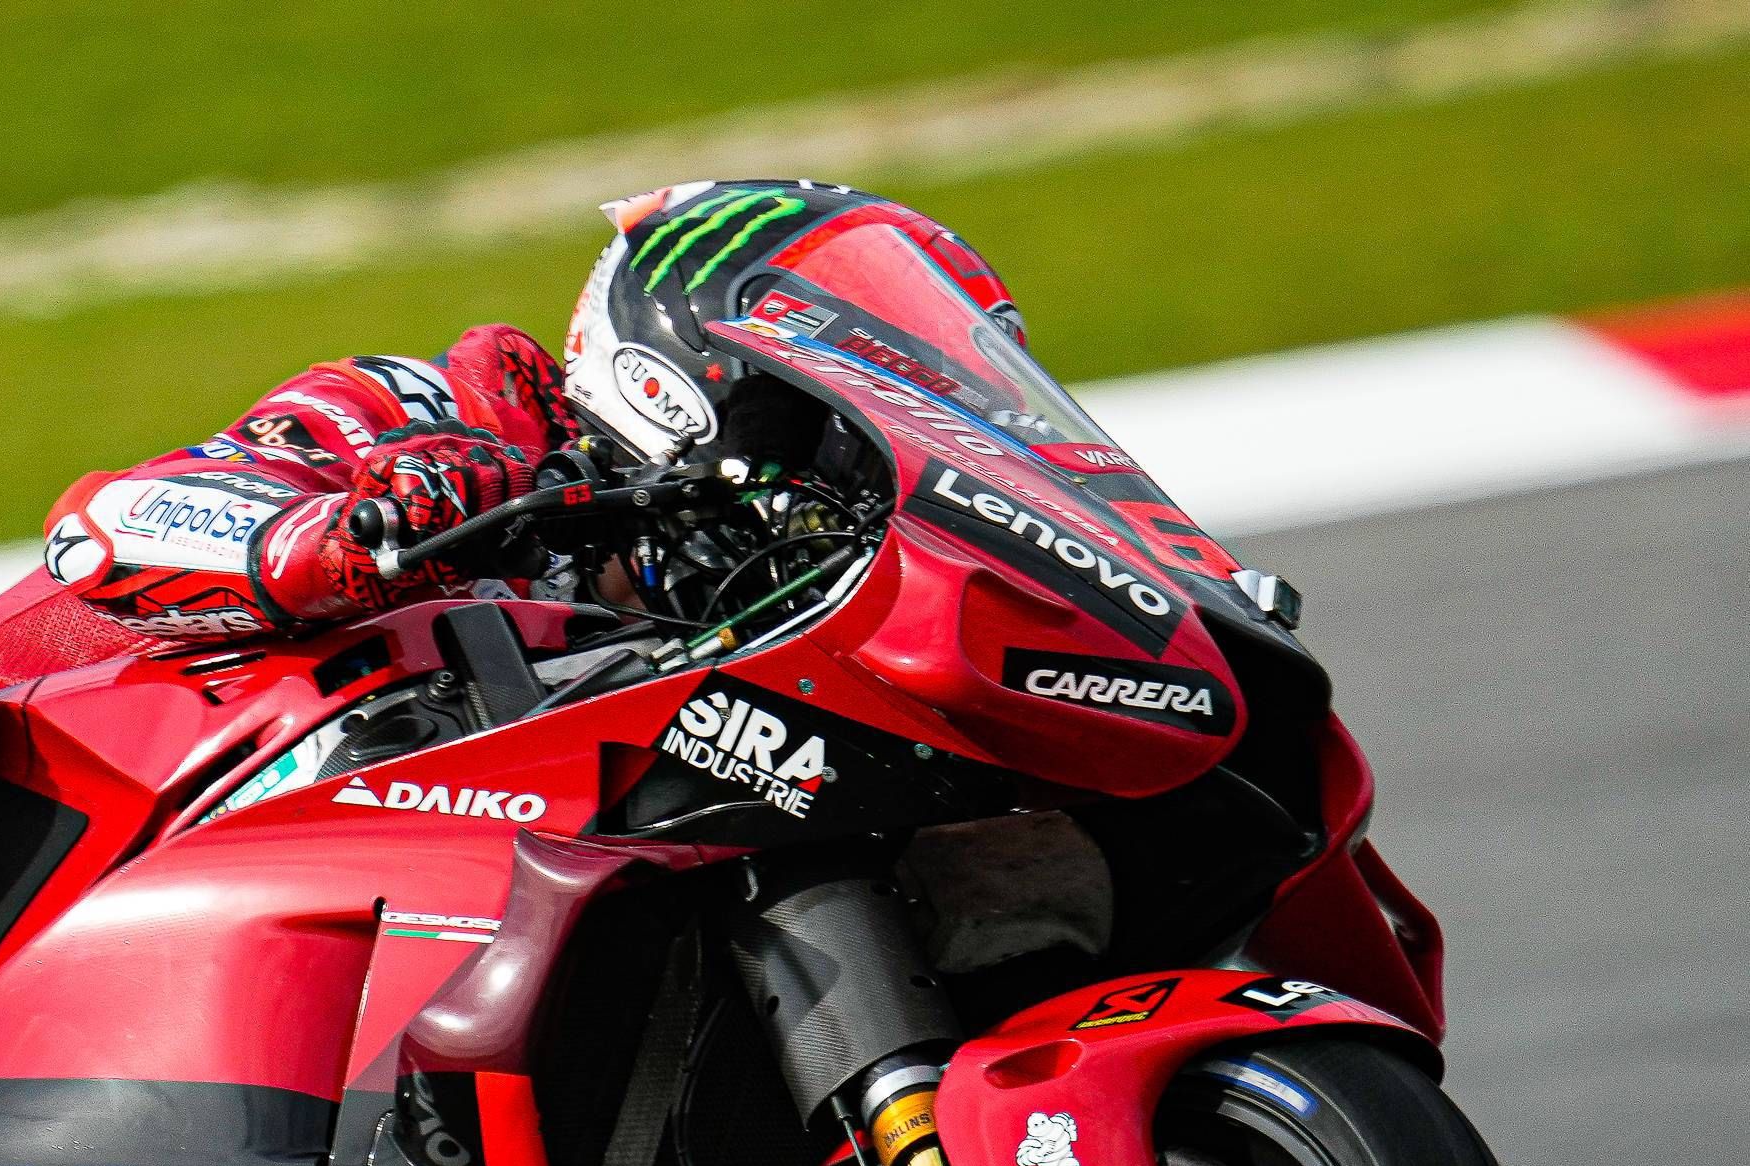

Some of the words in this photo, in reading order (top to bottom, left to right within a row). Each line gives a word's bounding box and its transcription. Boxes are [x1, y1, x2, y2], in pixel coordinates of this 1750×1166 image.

[933, 468, 1171, 617] Lenovo
[1026, 668, 1213, 716] CARRERA
[661, 728, 815, 819] INDUSTRIE
[678, 690, 829, 787] SIRA
[384, 782, 546, 823] DAIKO
